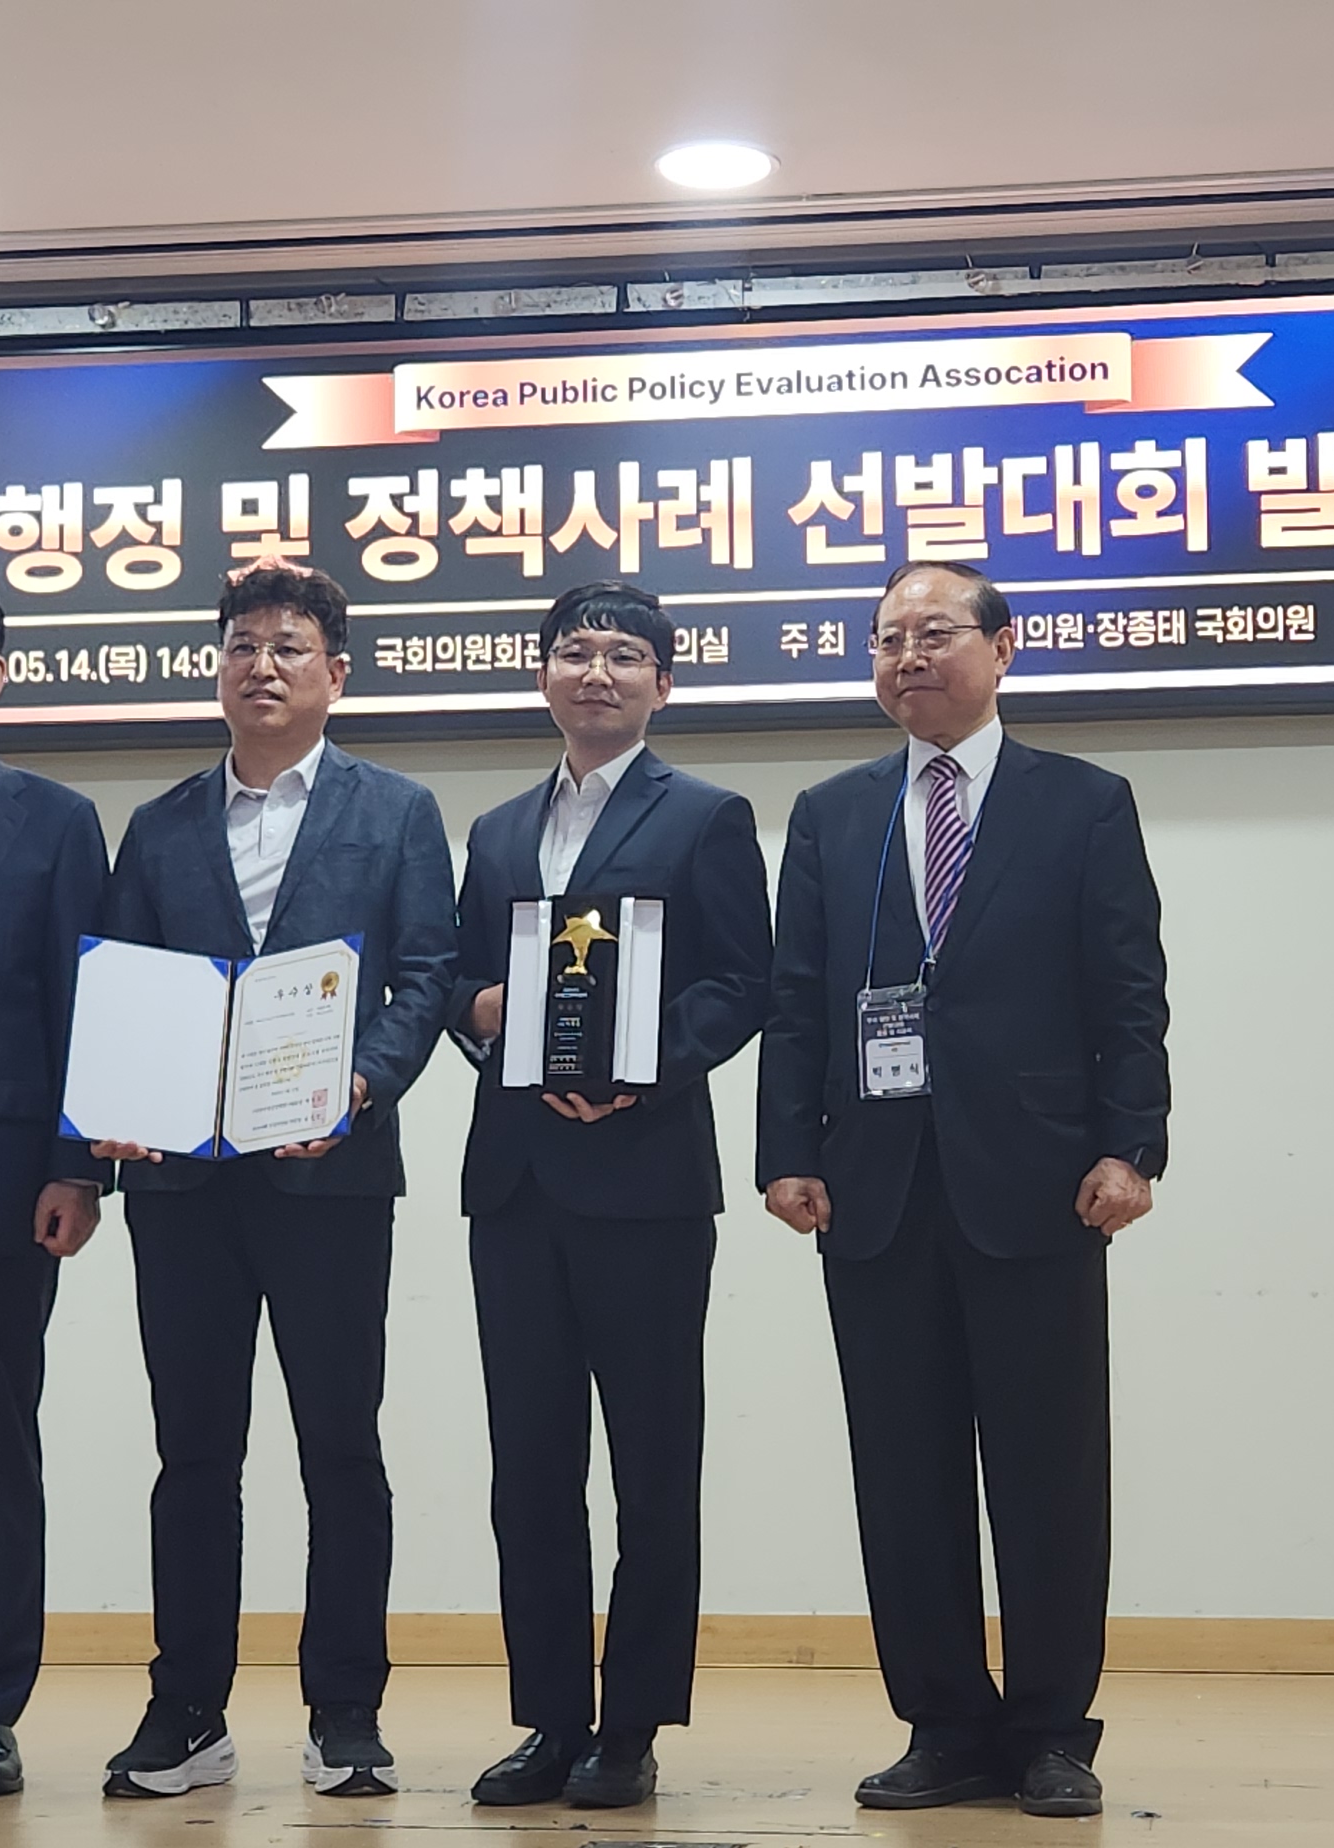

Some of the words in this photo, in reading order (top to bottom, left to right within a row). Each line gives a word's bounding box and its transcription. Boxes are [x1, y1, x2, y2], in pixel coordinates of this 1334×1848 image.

[415, 384, 510, 411] Korea
[518, 378, 618, 406] Public
[627, 374, 725, 404] Policy
[735, 366, 908, 397] Evaluation
[918, 356, 1110, 389] Assocation
[345, 456, 754, 581] 정책사례
[787, 437, 1208, 564] 선발대회
[156, 644, 221, 679] 14:0
[672, 626, 729, 664] 의실
[1194, 605, 1316, 643] 국회의원
